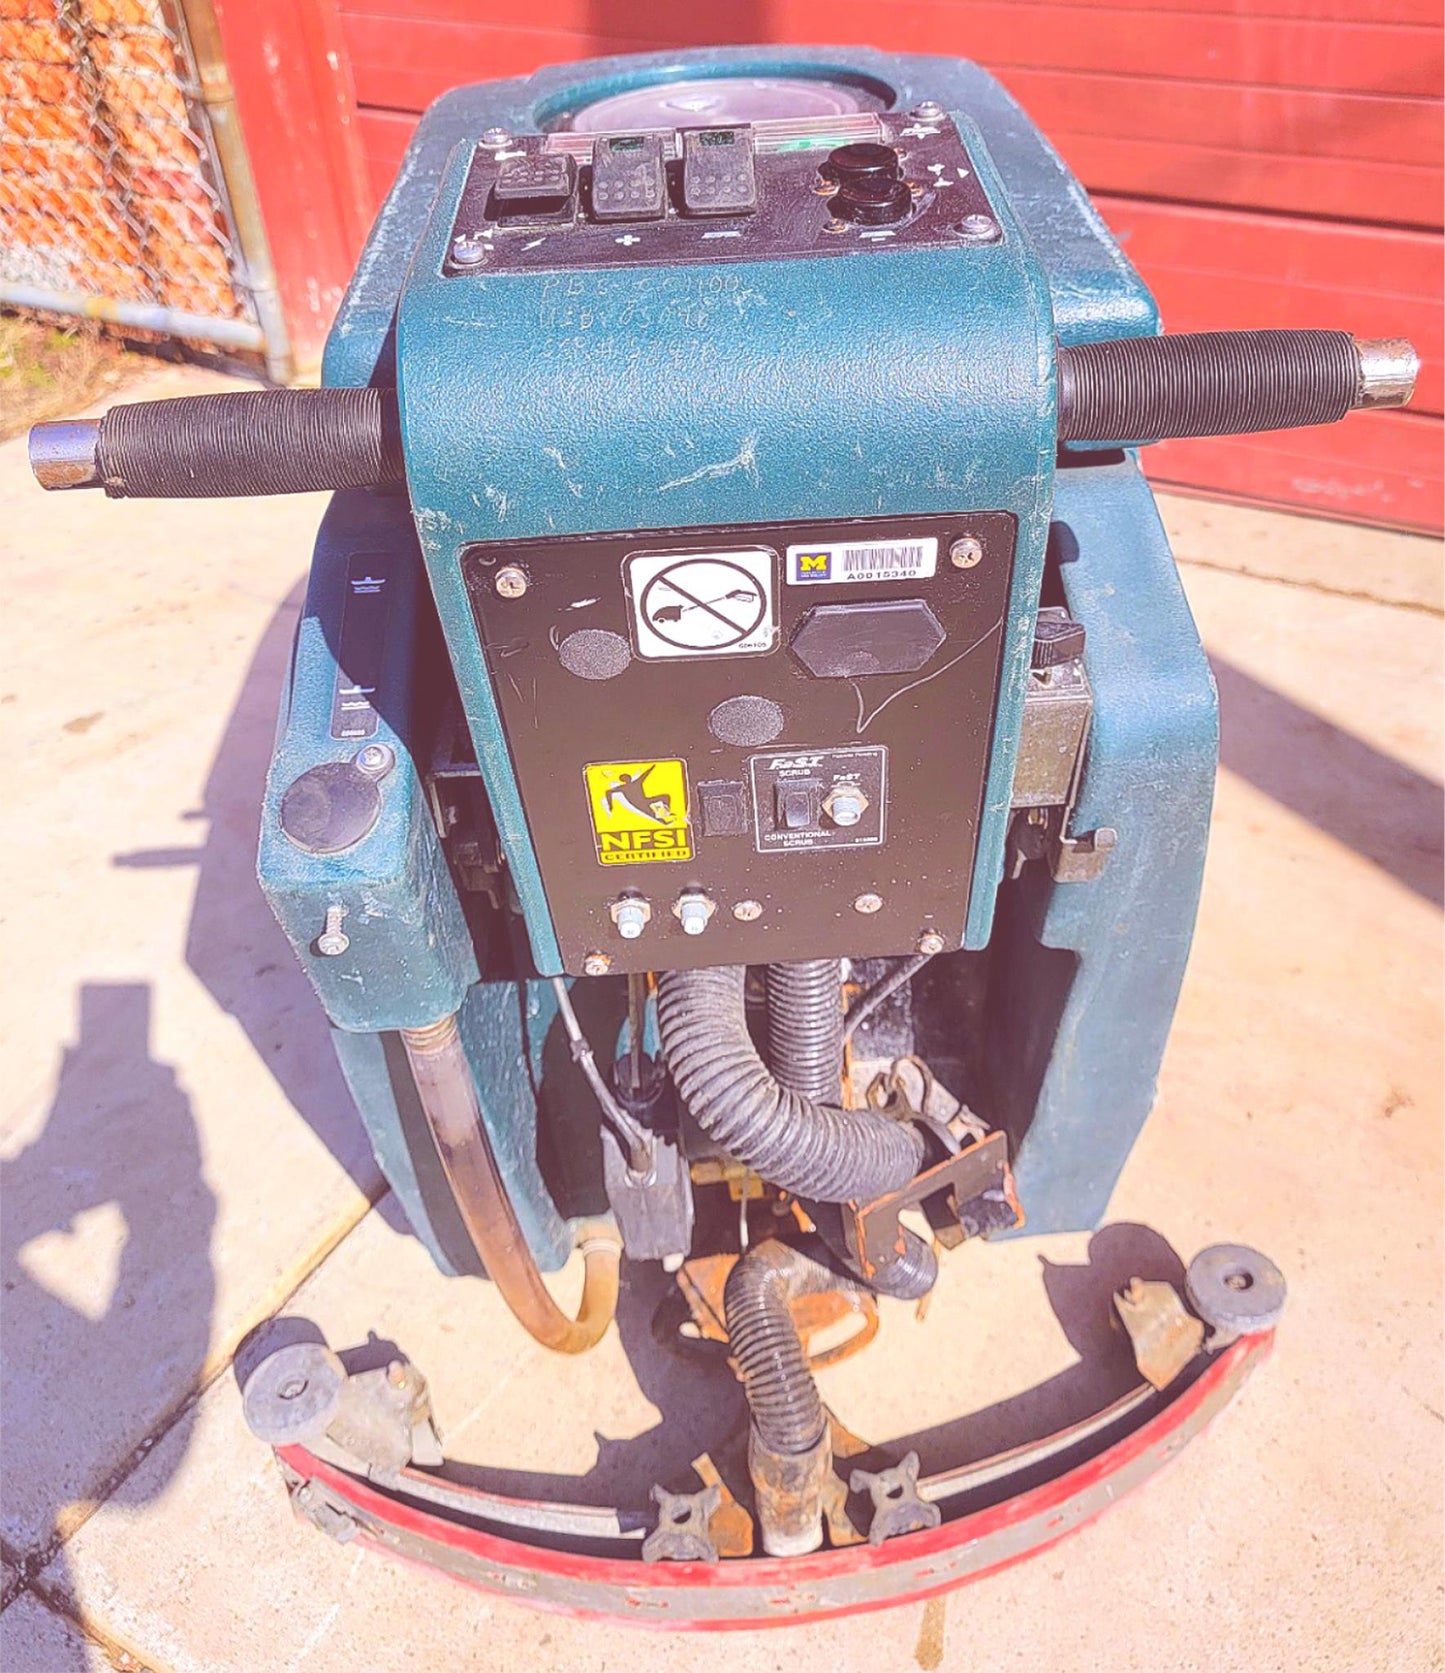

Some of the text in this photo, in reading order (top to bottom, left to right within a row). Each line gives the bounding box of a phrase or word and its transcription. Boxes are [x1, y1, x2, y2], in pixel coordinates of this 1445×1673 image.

[847, 570, 917, 580] A0015340
[779, 768, 811, 777] SCRUB
[601, 829, 687, 851] NFSI
[764, 830, 832, 841] CONVENTIONAL
[783, 839, 814, 847] SCRUB
[604, 850, 687, 861] CERTIFIED
